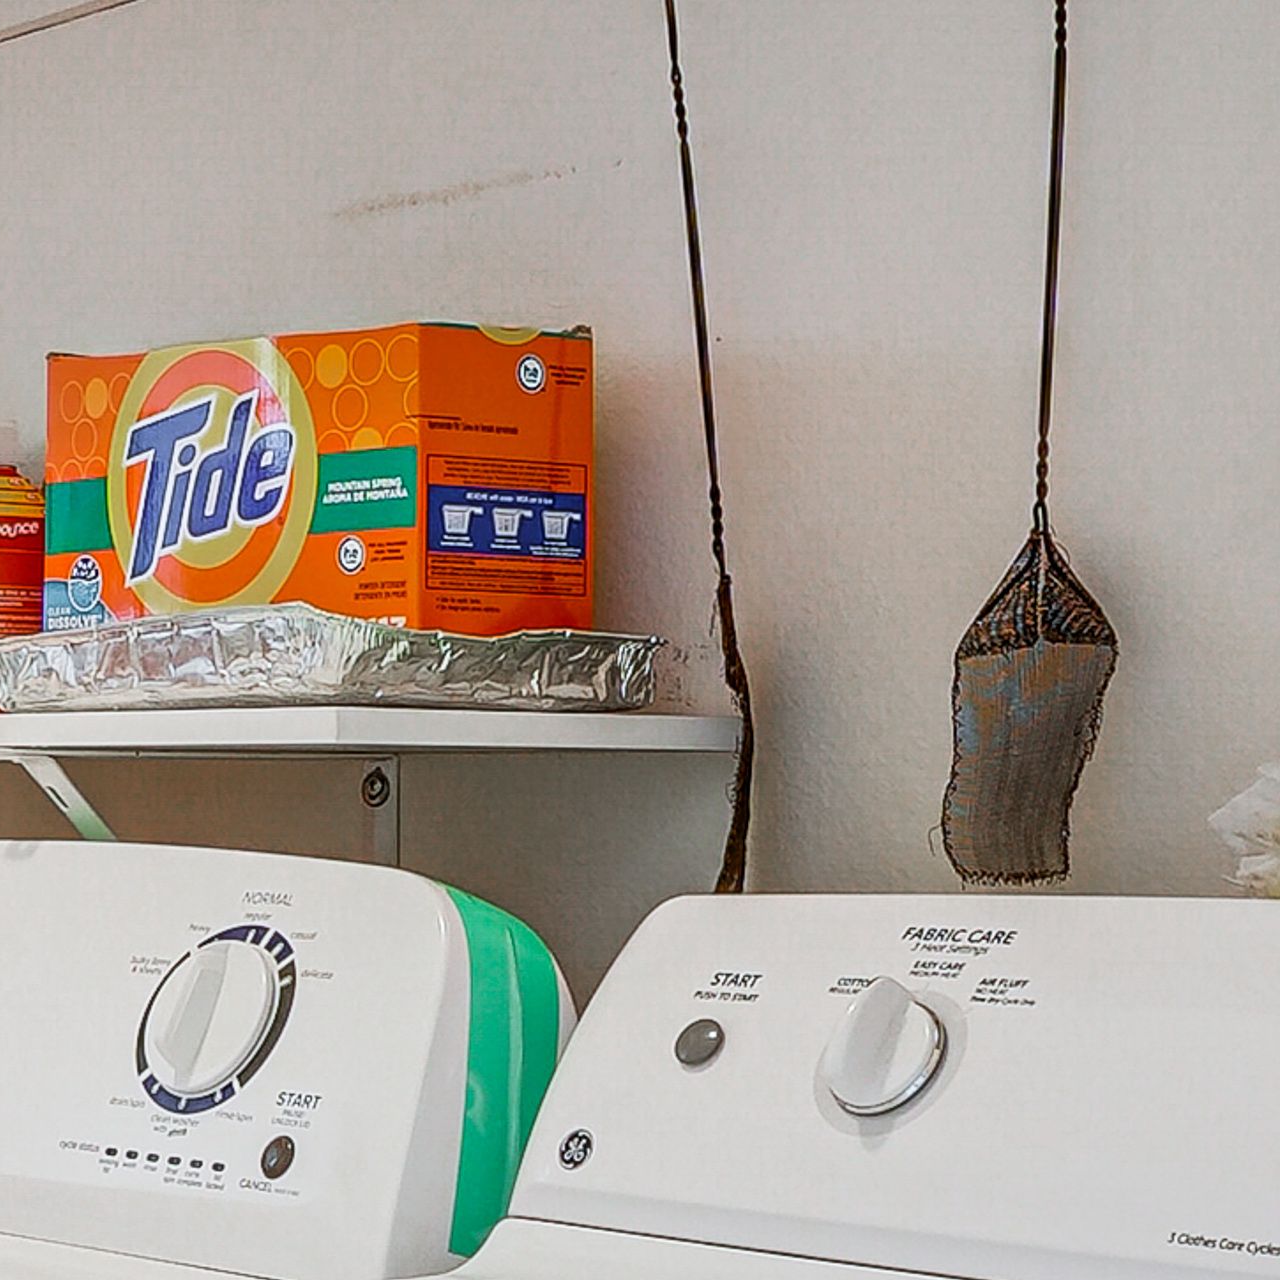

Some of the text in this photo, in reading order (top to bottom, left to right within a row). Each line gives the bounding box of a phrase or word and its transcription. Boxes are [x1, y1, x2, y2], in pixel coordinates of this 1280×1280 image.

[125, 389, 295, 589] Tide
[328, 477, 402, 493] MOUNTAIN SPRING
[323, 491, 351, 505] AROMA
[354, 492, 365, 503] DE
[48, 615, 97, 631] DISSOLVE
[242, 892, 293, 906] NORMAL
[901, 927, 1018, 945] FABRIC CARE
[710, 972, 763, 988] START
[276, 1092, 322, 1110] START
